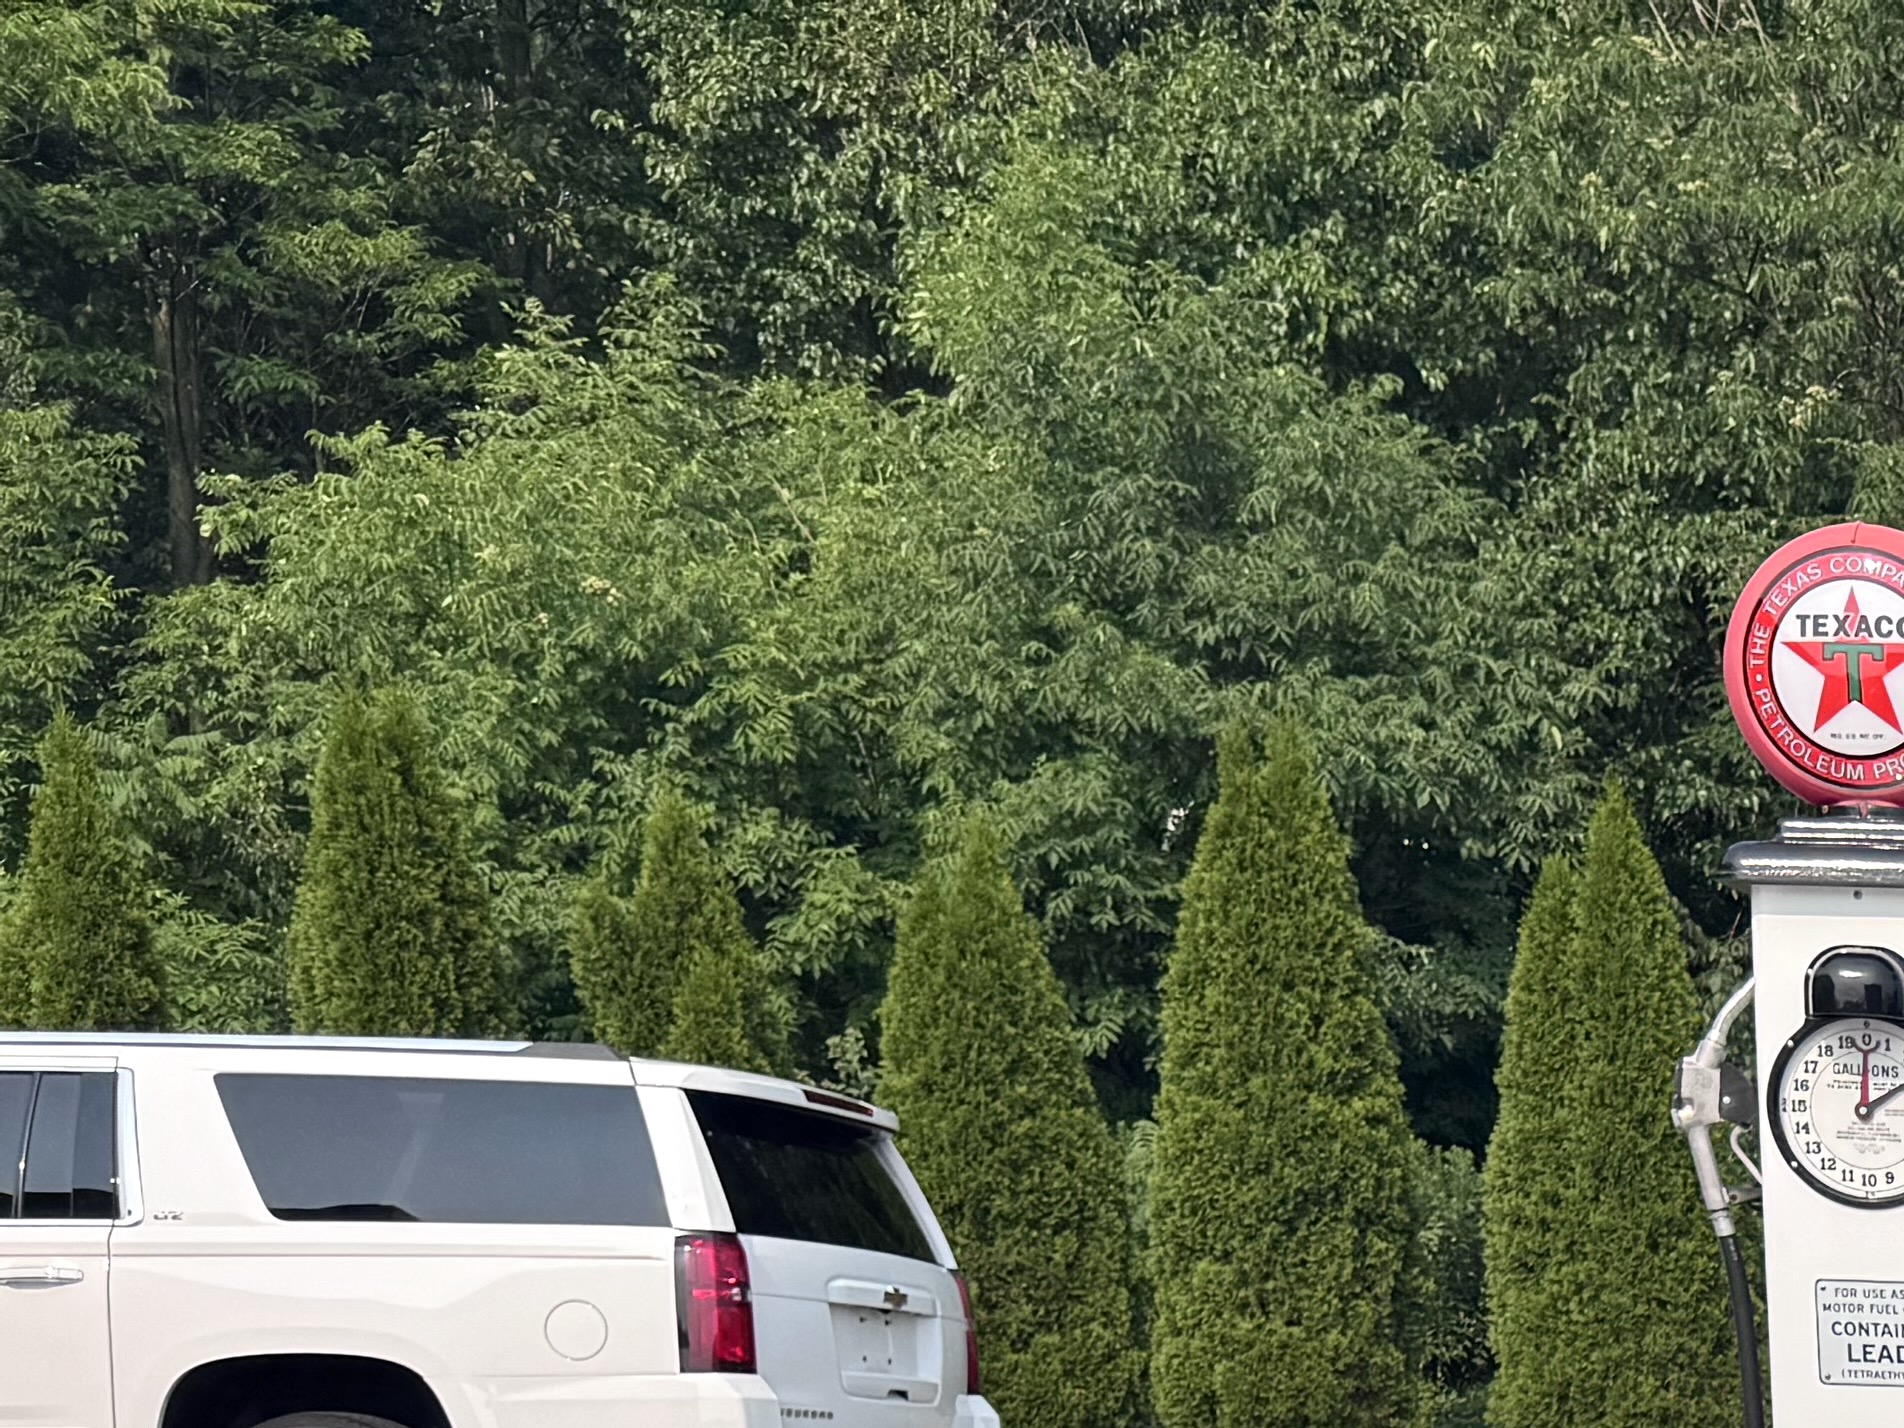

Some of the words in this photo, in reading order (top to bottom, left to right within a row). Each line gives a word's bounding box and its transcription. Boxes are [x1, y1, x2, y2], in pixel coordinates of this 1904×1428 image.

[1750, 624, 1769, 668] THE
[1763, 562, 1822, 616] TEXAS
[1755, 688, 1864, 781] PETROLEUM
[1862, 1034, 1872, 1046] 0
[1885, 1038, 1891, 1051] 1
[1817, 1044, 1834, 1057] 18
[1804, 1061, 1818, 1074] 17
[1793, 1079, 1809, 1091] 16
[1791, 1100, 1807, 1112] 15
[1794, 1122, 1810, 1134] 14
[1805, 1142, 1821, 1154] 13
[1820, 1158, 1836, 1171] 12
[1841, 1169, 1854, 1182] 11
[1862, 1174, 1877, 1187] 10
[1885, 1172, 1894, 1184] 9
[1834, 1287, 1857, 1298] FOR
[1863, 1289, 1886, 1299] USE
[1822, 1303, 1864, 1313] MOTOR
[1870, 1304, 1898, 1315] FUEL
